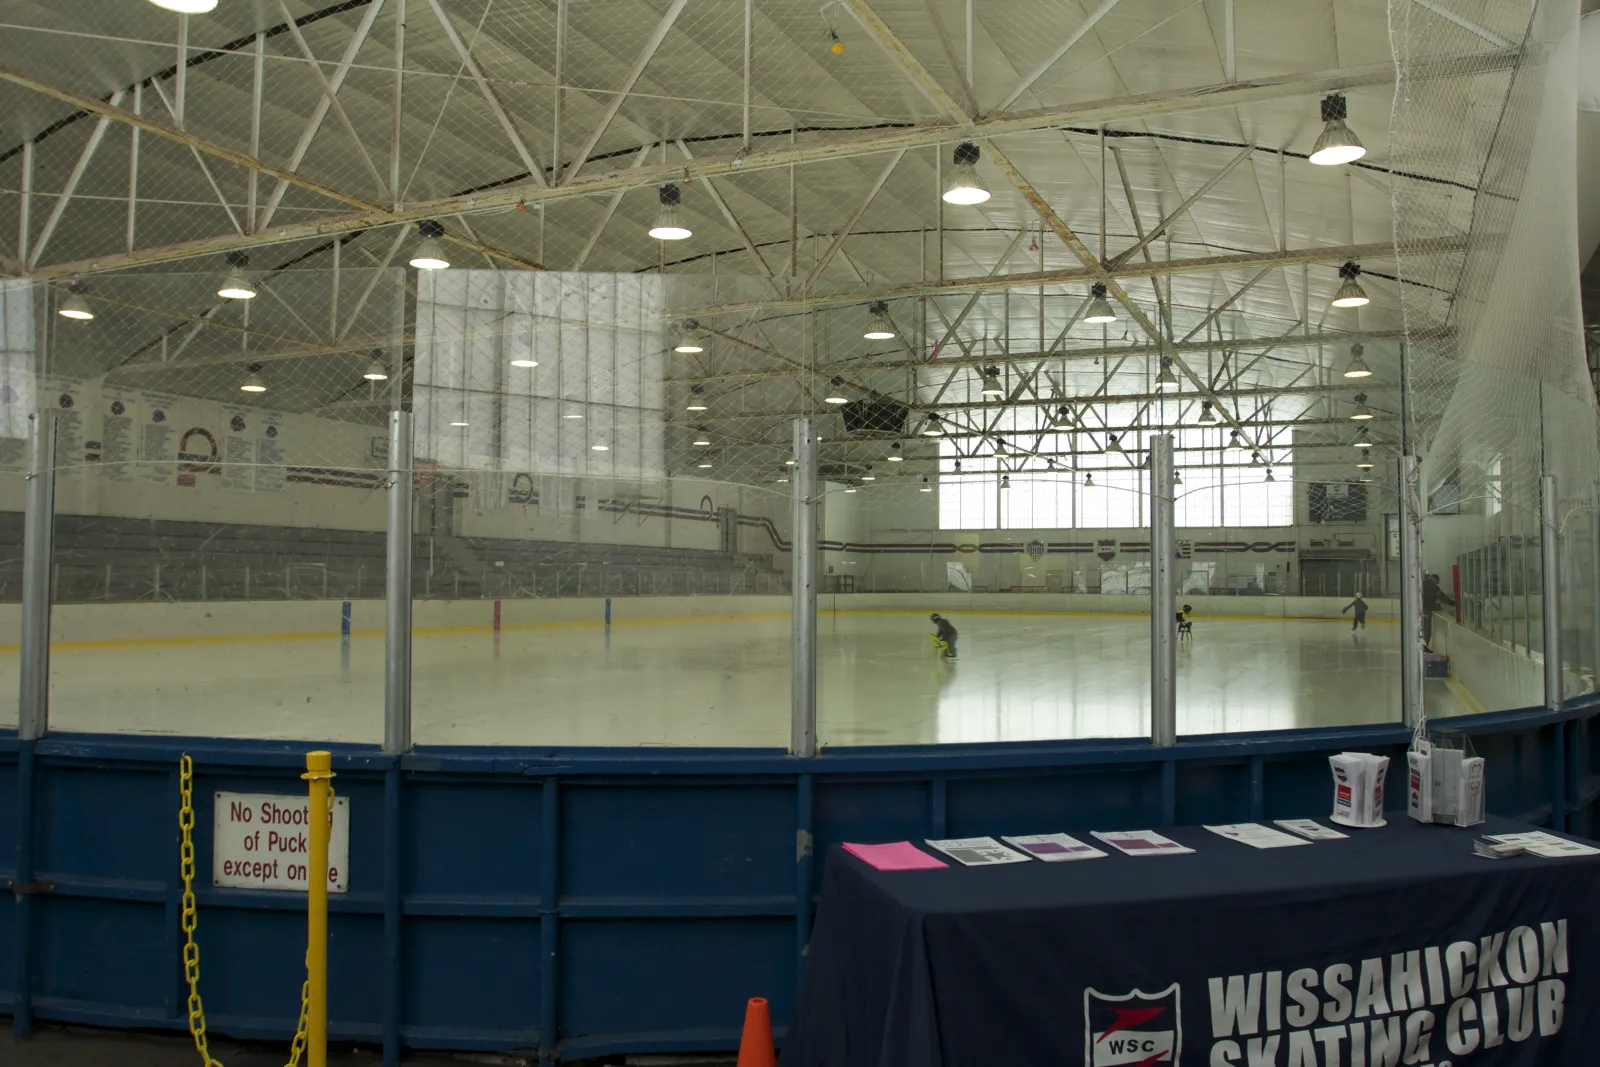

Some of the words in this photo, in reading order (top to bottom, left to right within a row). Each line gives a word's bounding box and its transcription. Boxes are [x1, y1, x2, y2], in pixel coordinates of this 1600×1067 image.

[231, 801, 252, 823] No
[261, 802, 333, 826] Shoot
[244, 831, 260, 851] of
[268, 831, 307, 853] Puck
[223, 859, 278, 883] except
[287, 865, 307, 881] on
[1207, 918, 1570, 1039] WISSAHICKON
[1445, 978, 1567, 1056] CLUB
[1108, 1039, 1155, 1055] WSC
